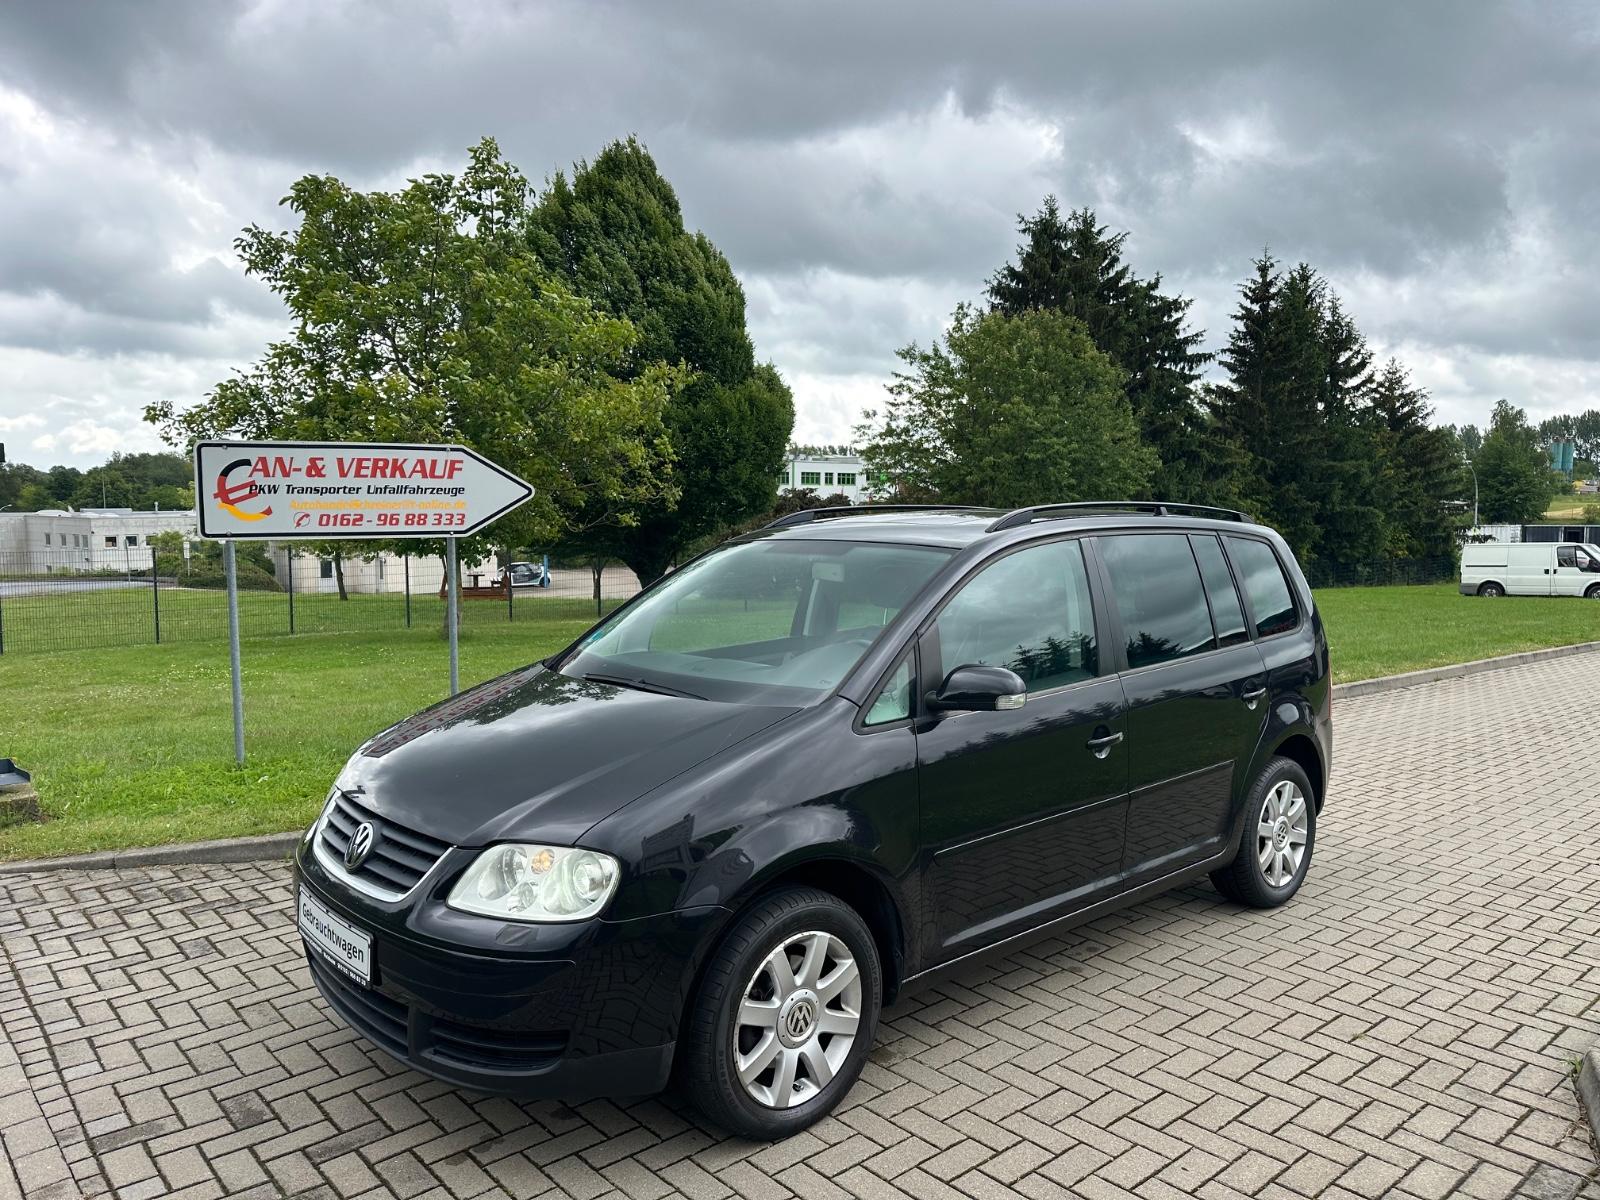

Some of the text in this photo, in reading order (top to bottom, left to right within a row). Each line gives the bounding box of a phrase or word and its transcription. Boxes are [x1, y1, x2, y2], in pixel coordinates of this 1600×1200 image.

[336, 457, 464, 480] VERKAUF
[249, 484, 465, 498] PKW Transporter Unfallfahrzeuge
[318, 513, 365, 527] 0162
[376, 513, 400, 526] 96
[404, 513, 428, 527] 88
[431, 513, 466, 526] 333
[302, 902, 365, 963] Gebrauchtwagen
